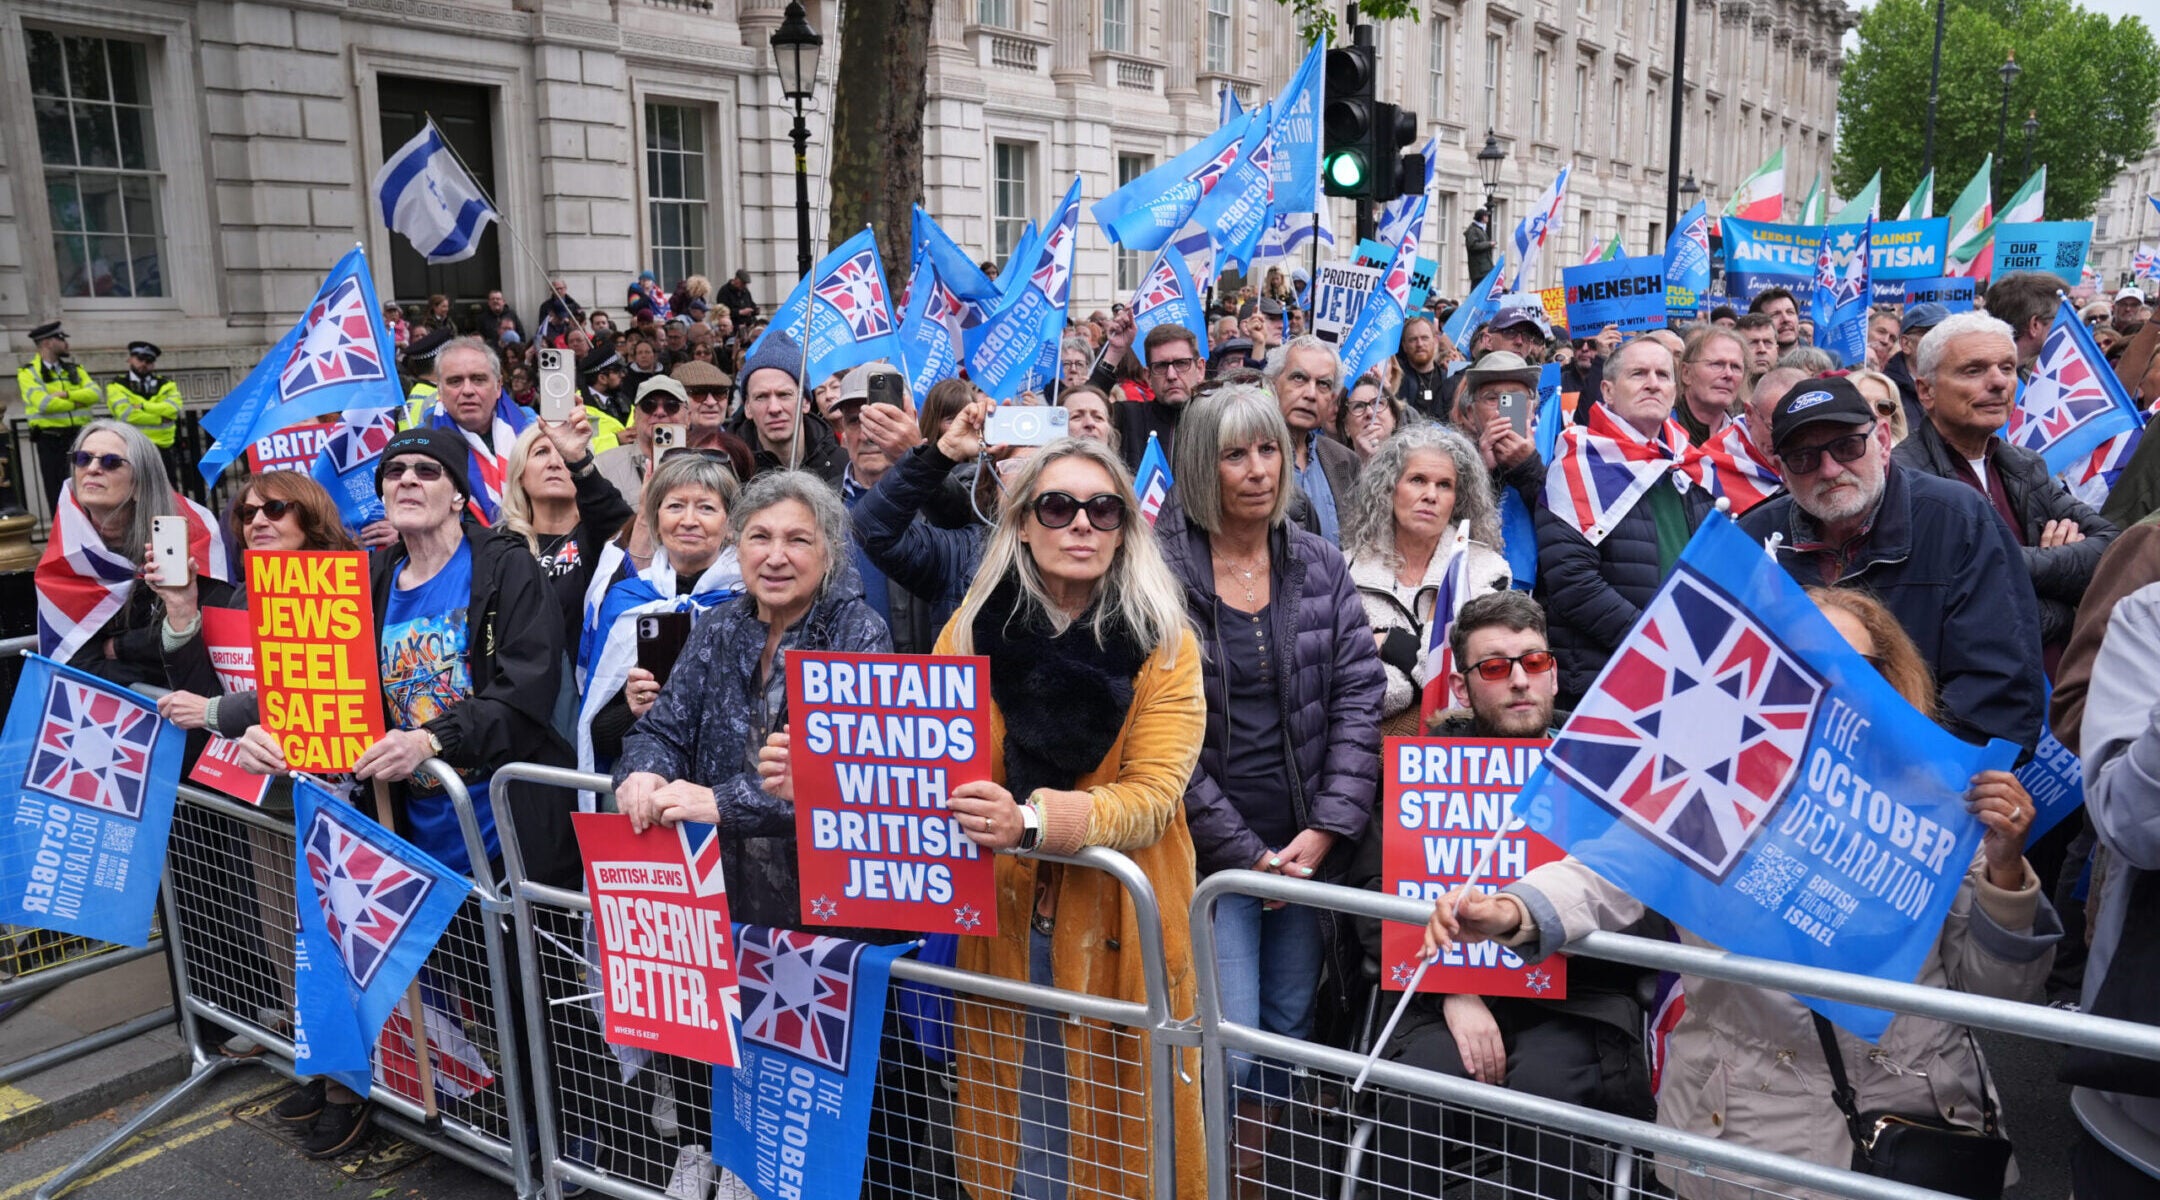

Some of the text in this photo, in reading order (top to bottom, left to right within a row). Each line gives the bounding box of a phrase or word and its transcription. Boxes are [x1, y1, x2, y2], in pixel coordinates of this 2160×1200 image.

[1733, 240, 1935, 269] ANTISMTISM
[1753, 229, 1792, 244] LEEDS
[1871, 232, 1922, 245] GAINST
[2010, 243, 2037, 254] OUR
[1322, 267, 1370, 290] PROTECT
[2004, 256, 2042, 267] FIGHT
[1316, 285, 1374, 325] JEW
[1567, 274, 1662, 305] #MENSCH
[1665, 296, 1695, 306] STOP
[1905, 288, 1973, 304] #MENSCH
[1627, 316, 1646, 326] WITH
[257, 429, 329, 460] BRITA
[252, 556, 360, 594] MAKE
[258, 597, 361, 639] JEWS
[212, 651, 244, 664] BRITISH
[260, 641, 366, 690] FEEL
[802, 660, 976, 710] BRITAIN
[266, 691, 368, 733] SAFE
[1823, 697, 1871, 761] THE
[806, 711, 976, 762] STANDS
[834, 762, 949, 810] WITH
[1808, 747, 1956, 875] OCTOBER
[812, 809, 979, 861] BRITISH
[1423, 836, 1528, 877] WITH
[1779, 793, 1935, 920] DECLARATION
[600, 868, 683, 887] BRITISH JEWS
[844, 858, 953, 905] JEWS
[1807, 874, 1860, 914] BRITISH
[1782, 905, 1836, 947] ISRAEL
[1794, 889, 1849, 930] FRIENDS OF
[598, 894, 728, 970] DESERVE
[608, 954, 719, 1031] BETTER.
[614, 1026, 635, 1036] WHERE
[636, 1030, 642, 1038] IS
[816, 1078, 843, 1120] THE
[757, 1056, 787, 1193] DECLARATION
[778, 1066, 815, 1200] OCTOBER
